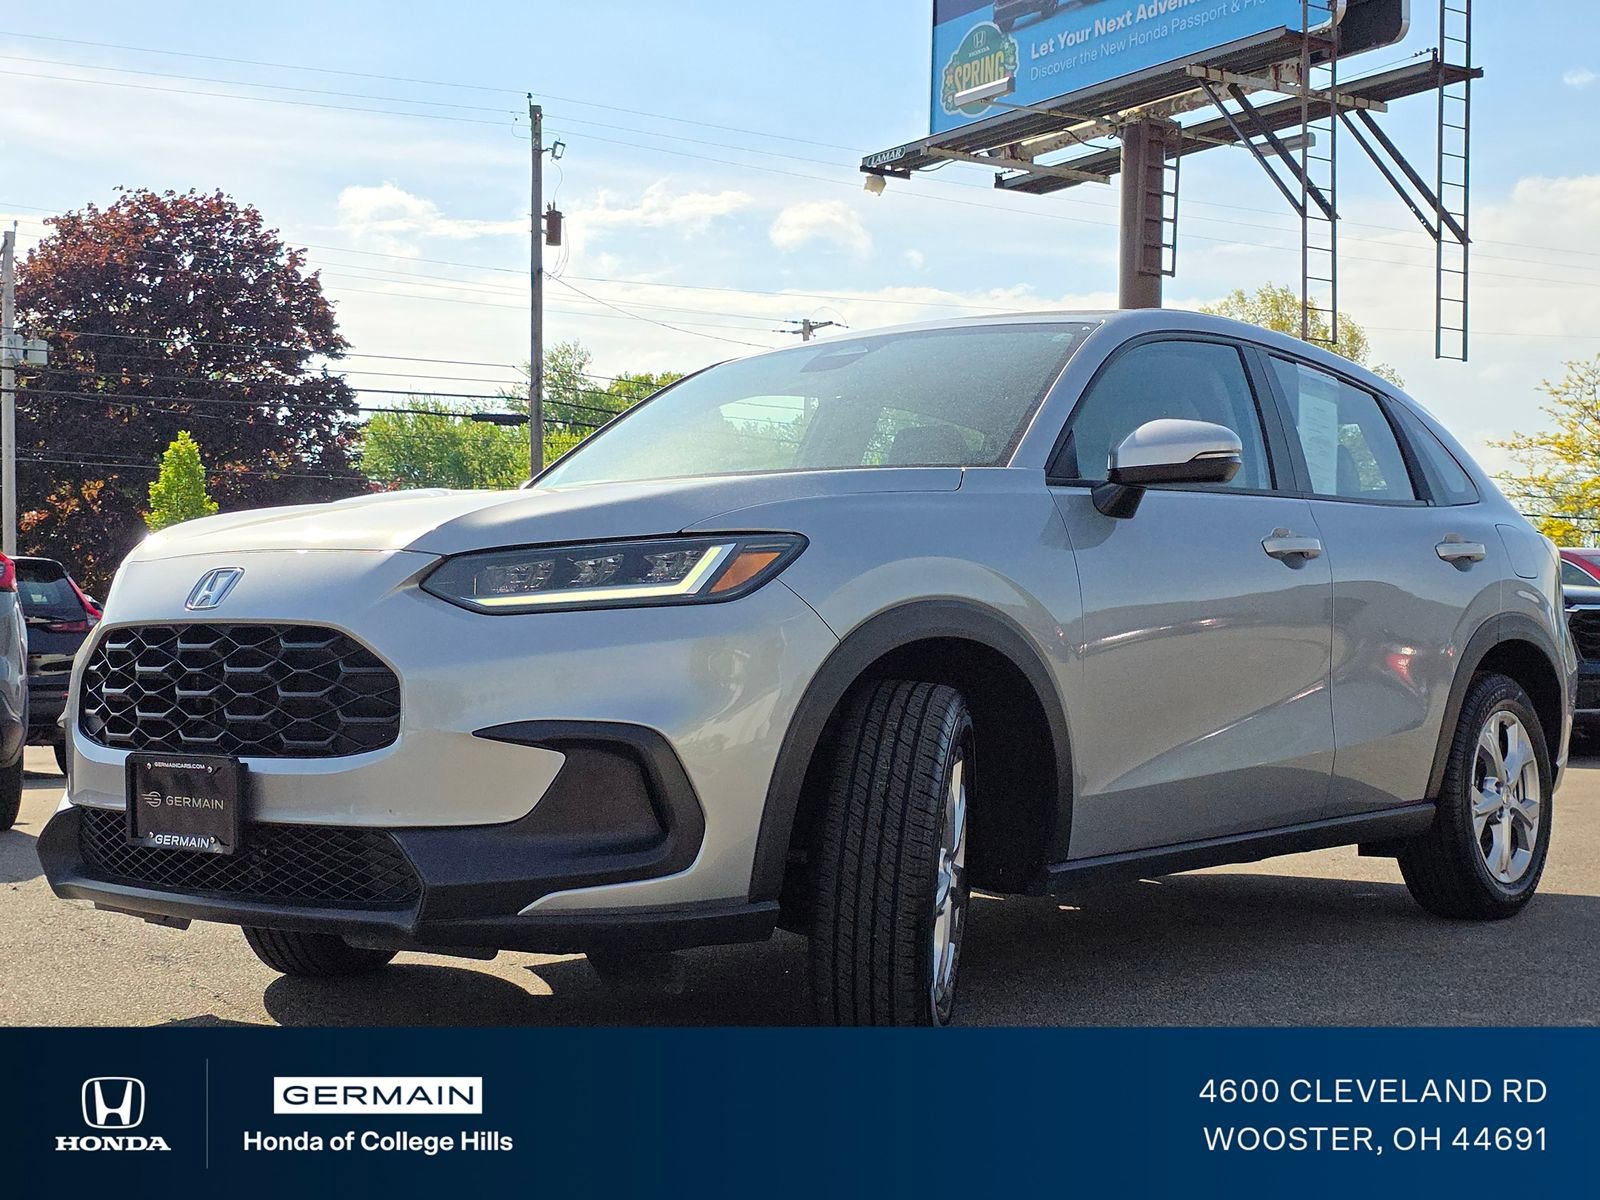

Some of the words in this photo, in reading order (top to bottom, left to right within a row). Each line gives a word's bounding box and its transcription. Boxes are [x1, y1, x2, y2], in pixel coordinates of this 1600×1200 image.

[1030, 55, 1077, 80] Discover
[1079, 48, 1097, 64] the
[1100, 39, 1126, 57] New
[1128, 24, 1168, 47] Honda
[1171, 3, 1227, 33] Passport
[1031, 38, 1055, 59] Let
[1057, 27, 1091, 49] Your
[1094, 10, 1133, 37] Next
[1135, 0, 1201, 23] Adven
[954, 51, 1005, 93] SPRING
[871, 149, 902, 166] LAMAR
[165, 795, 224, 810] GERMAIN
[154, 834, 209, 848] GERMAIN
